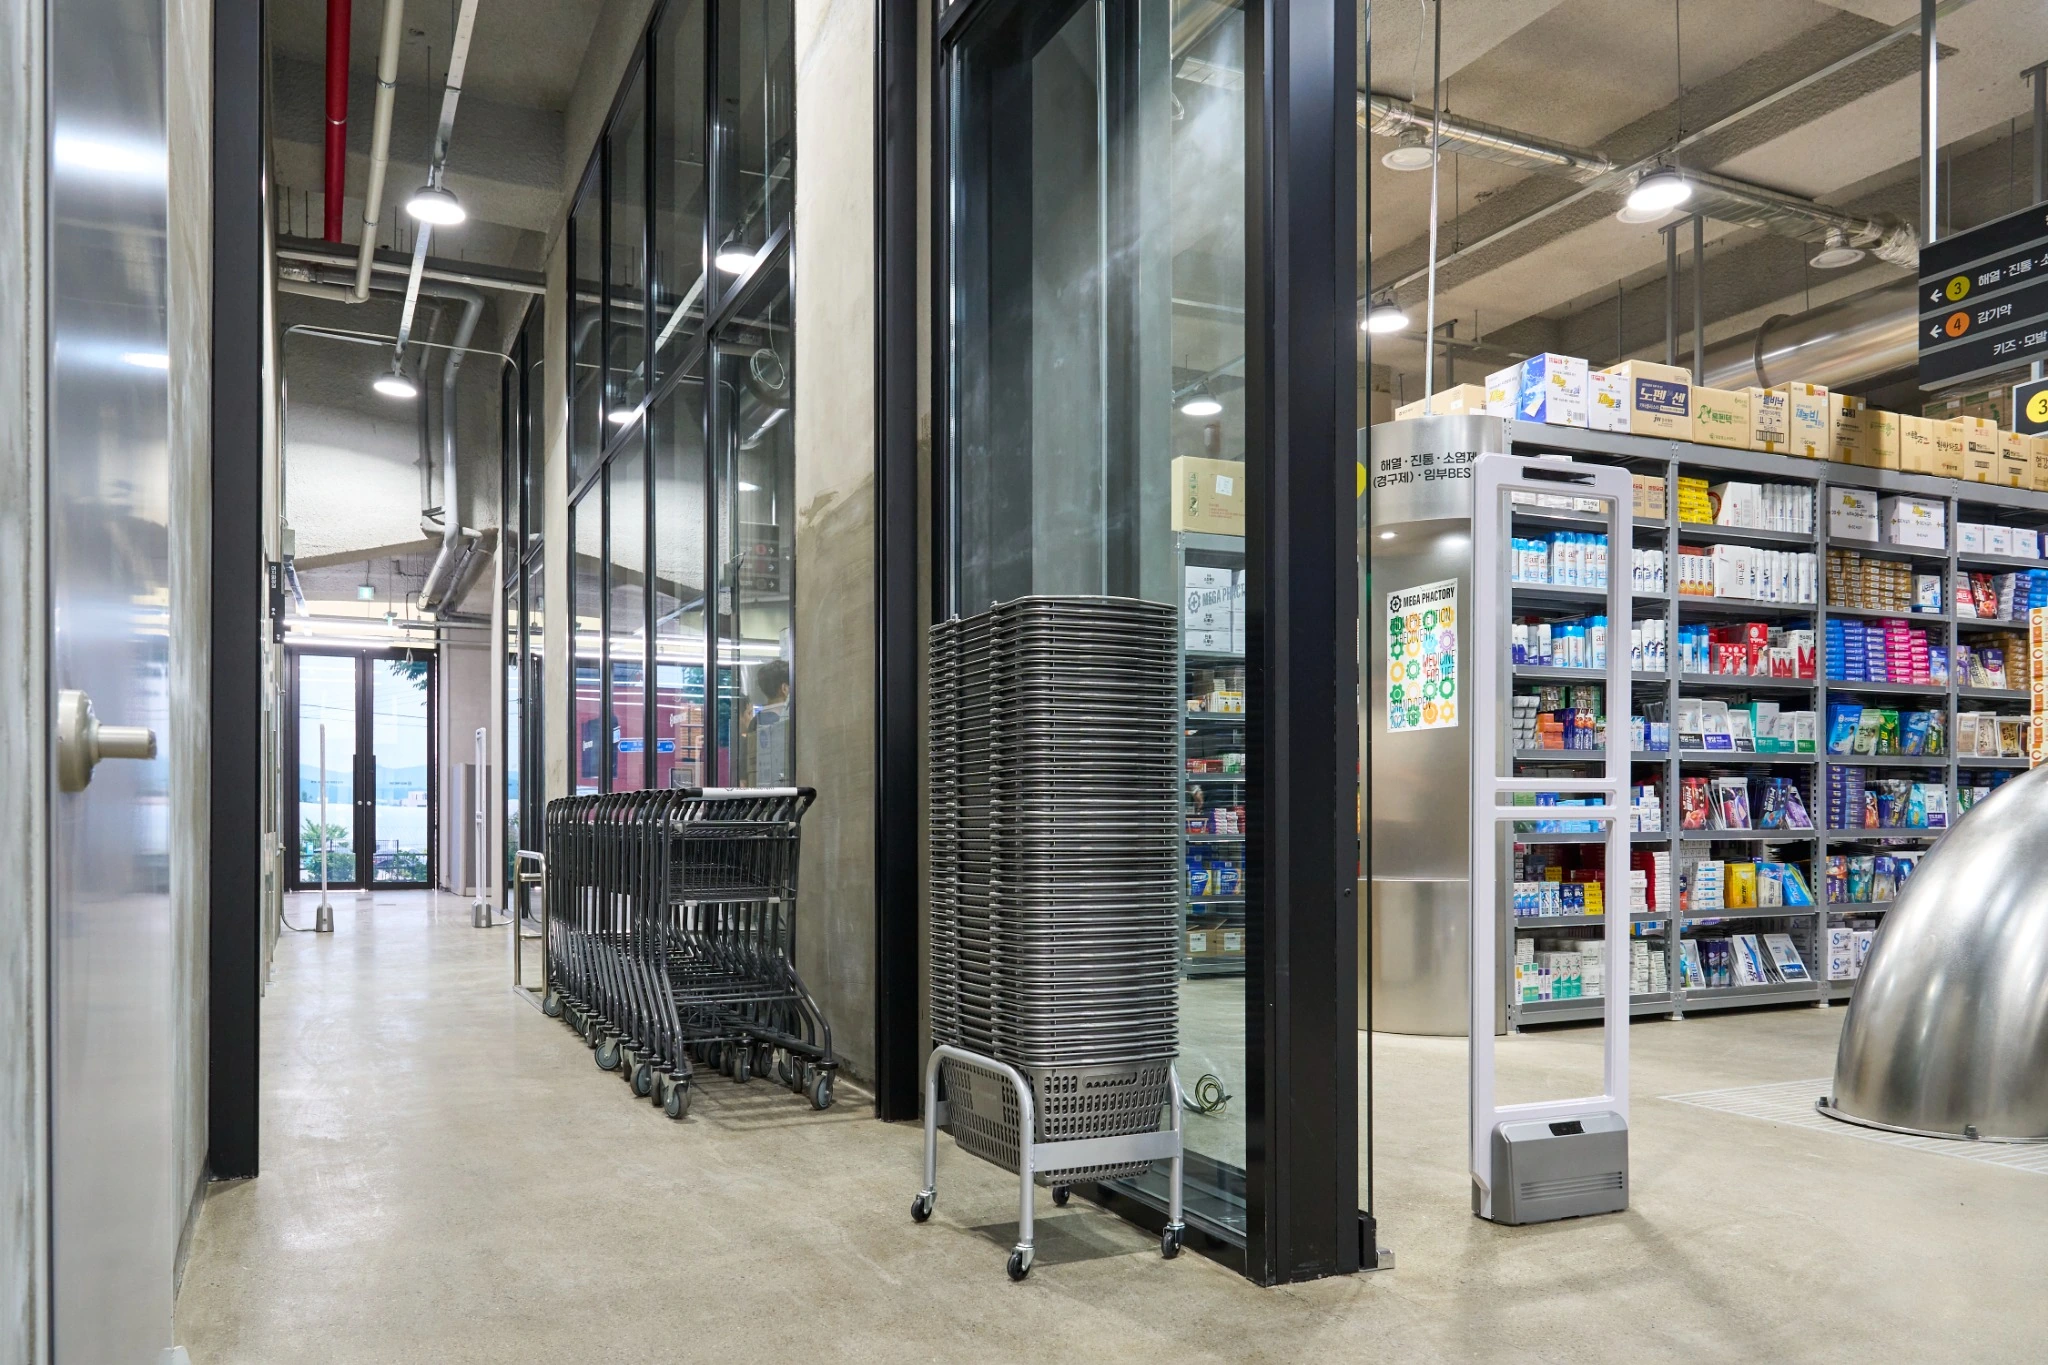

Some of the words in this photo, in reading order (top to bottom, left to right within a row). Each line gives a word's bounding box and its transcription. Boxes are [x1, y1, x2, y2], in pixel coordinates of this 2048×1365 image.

[1978, 269, 2000, 286] 해열
[2008, 259, 2032, 277] 진통
[1953, 282, 1962, 295] 3
[1977, 303, 2012, 324] 감기약
[1953, 318, 1962, 331] 4
[1993, 339, 2017, 355] 키즈
[2023, 330, 2047, 348] 모발
[2038, 398, 2048, 415] 3
[1381, 457, 1402, 472] 해열
[1410, 453, 1434, 467] 진통
[1443, 451, 1477, 464] 소염제
[1373, 470, 1414, 488] (경구제)
[1424, 467, 1471, 481] 임부BES
[1202, 589, 1221, 607] MEGA
[1222, 583, 1245, 602] PHACT
[1403, 594, 1420, 607] MEGA
[1421, 587, 1455, 604] PHACTORY
